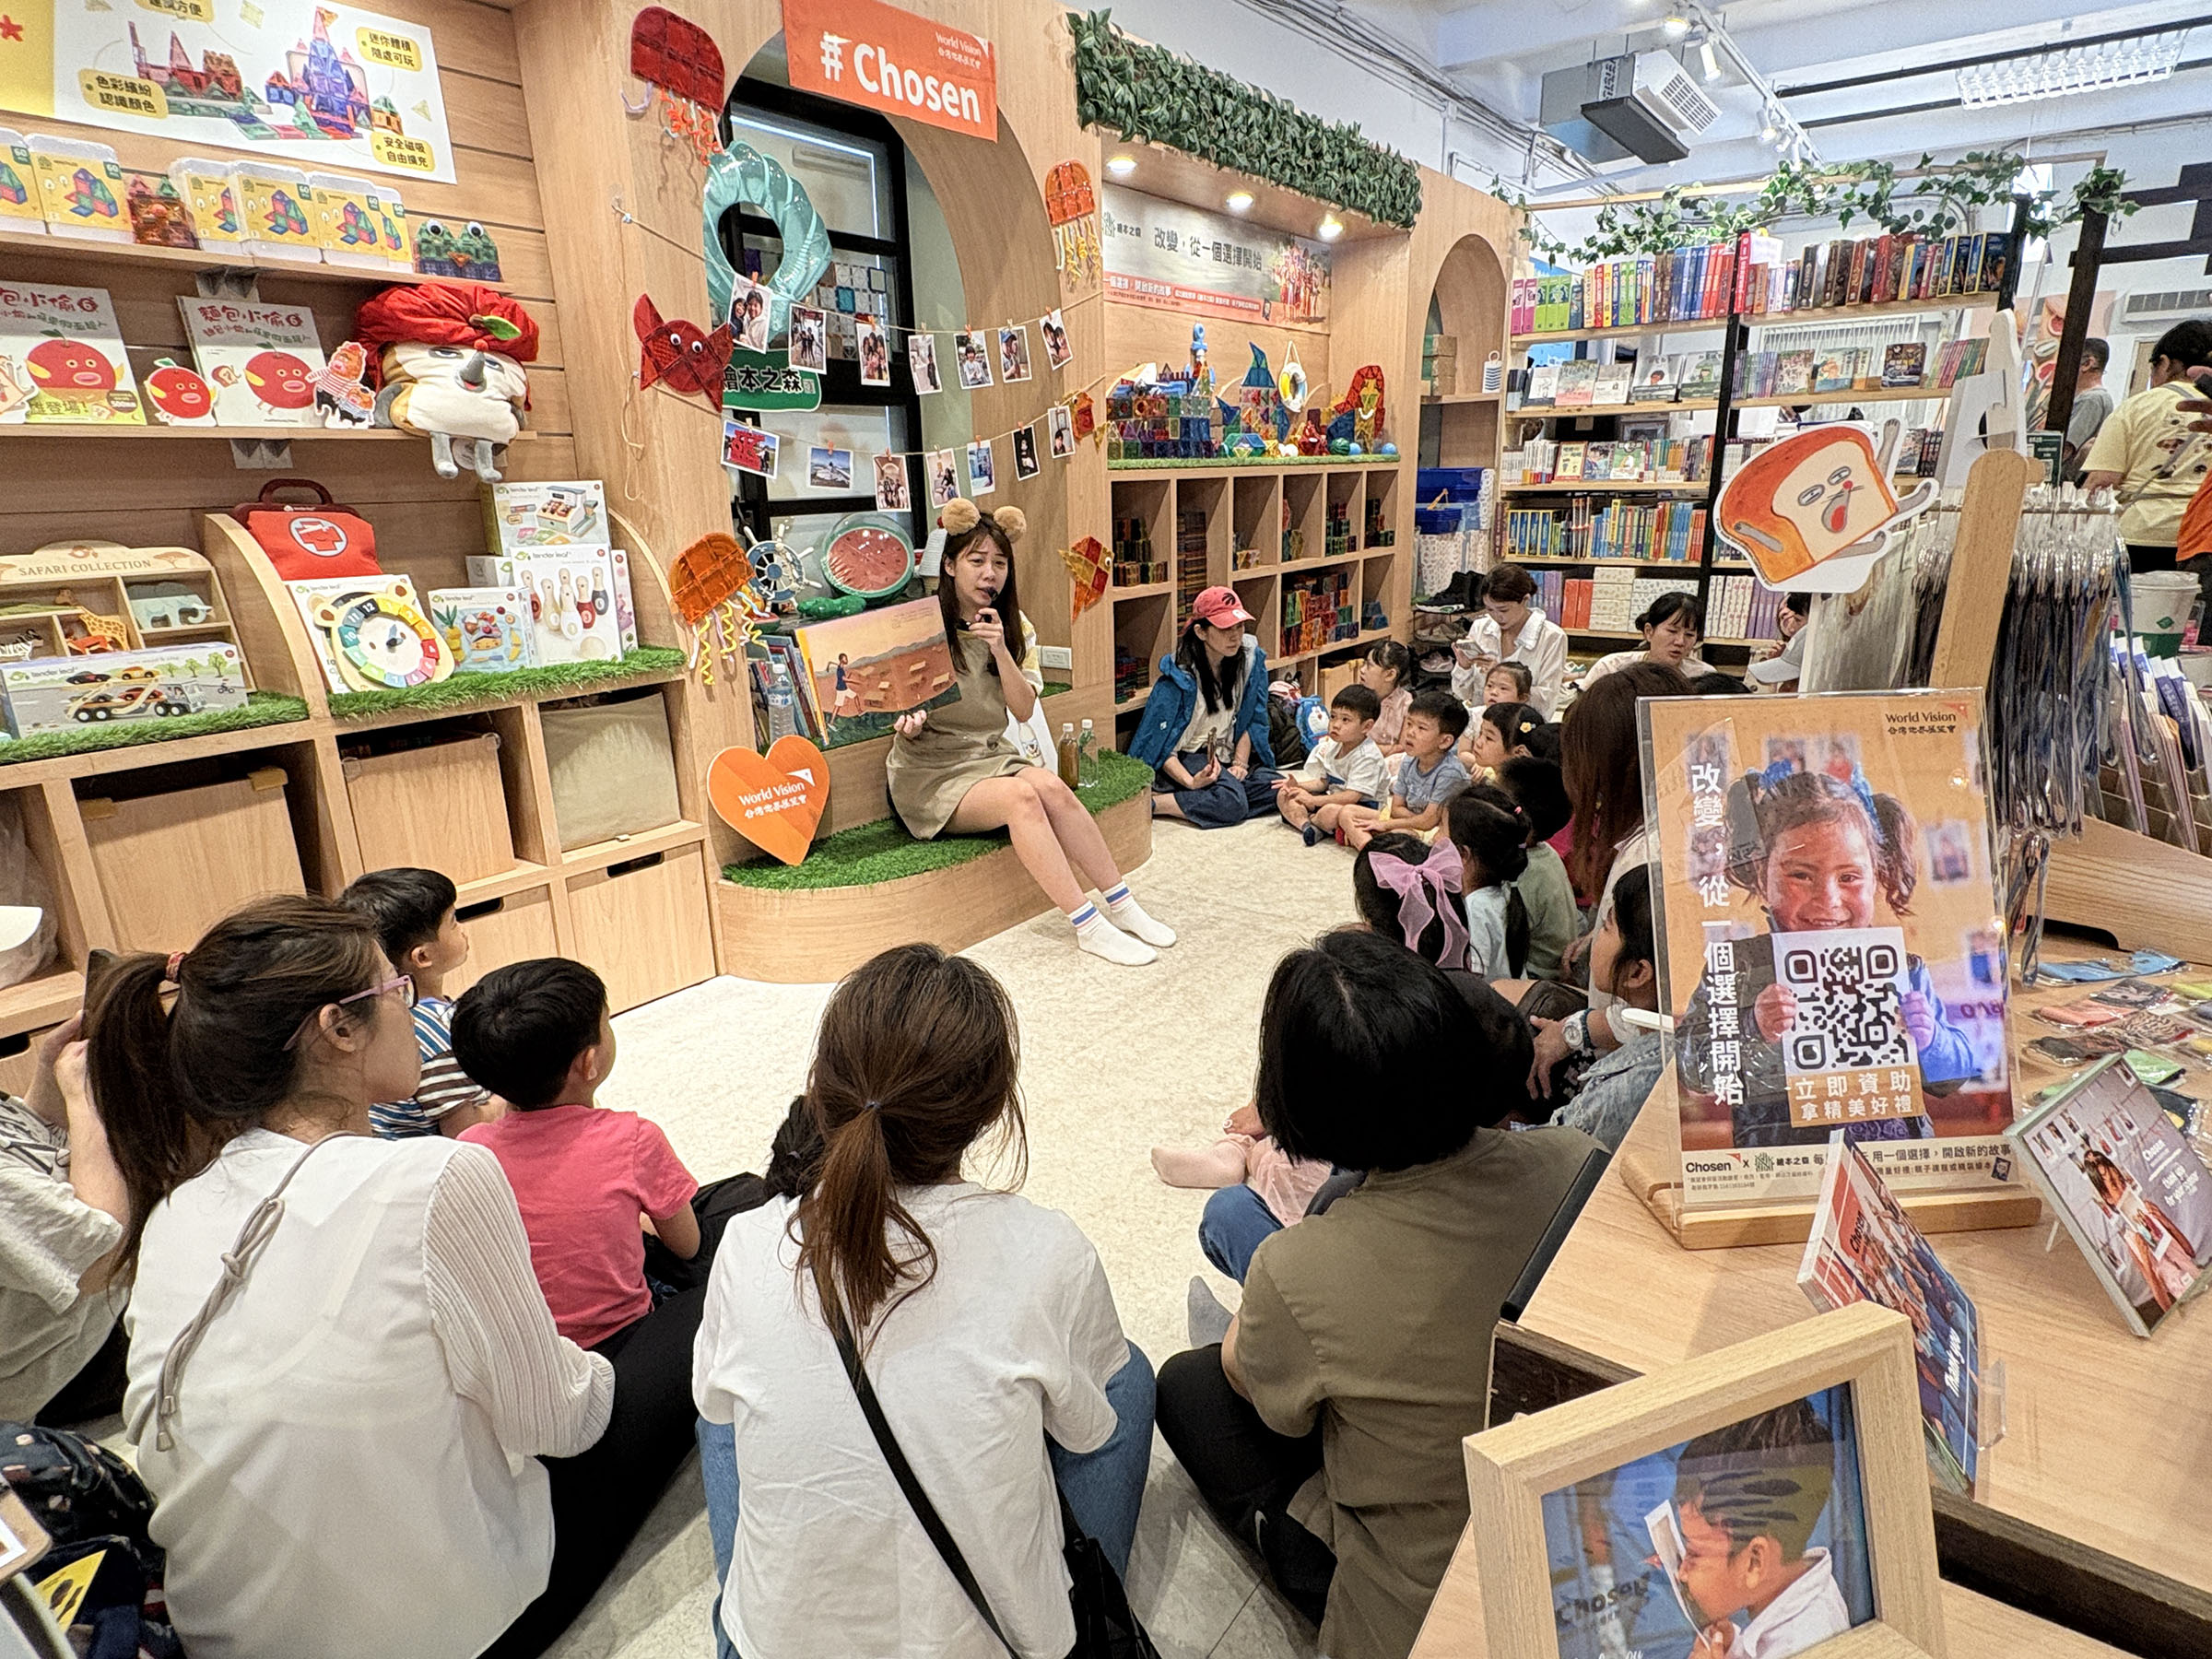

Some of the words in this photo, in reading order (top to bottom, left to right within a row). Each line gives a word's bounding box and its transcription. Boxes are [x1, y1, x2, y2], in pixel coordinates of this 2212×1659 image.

[935, 31, 959, 49] World
[960, 39, 982, 56] Vision
[18, 564, 67, 576] SAFARI
[70, 559, 152, 573] COLLECTION
[362, 602, 374, 613] 12
[347, 612, 360, 623] 11
[344, 631, 357, 642] 10
[1885, 711, 1920, 724] World
[1921, 711, 1957, 723] Vision
[738, 787, 773, 806] World
[772, 782, 806, 797] Vision
[1691, 763, 1745, 1106] 改變，從一個選擇開始
[1795, 1069, 1912, 1100] 立即資助
[1801, 1095, 1912, 1122] 拿精美好禮
[1685, 1161, 1732, 1173] Chosen
